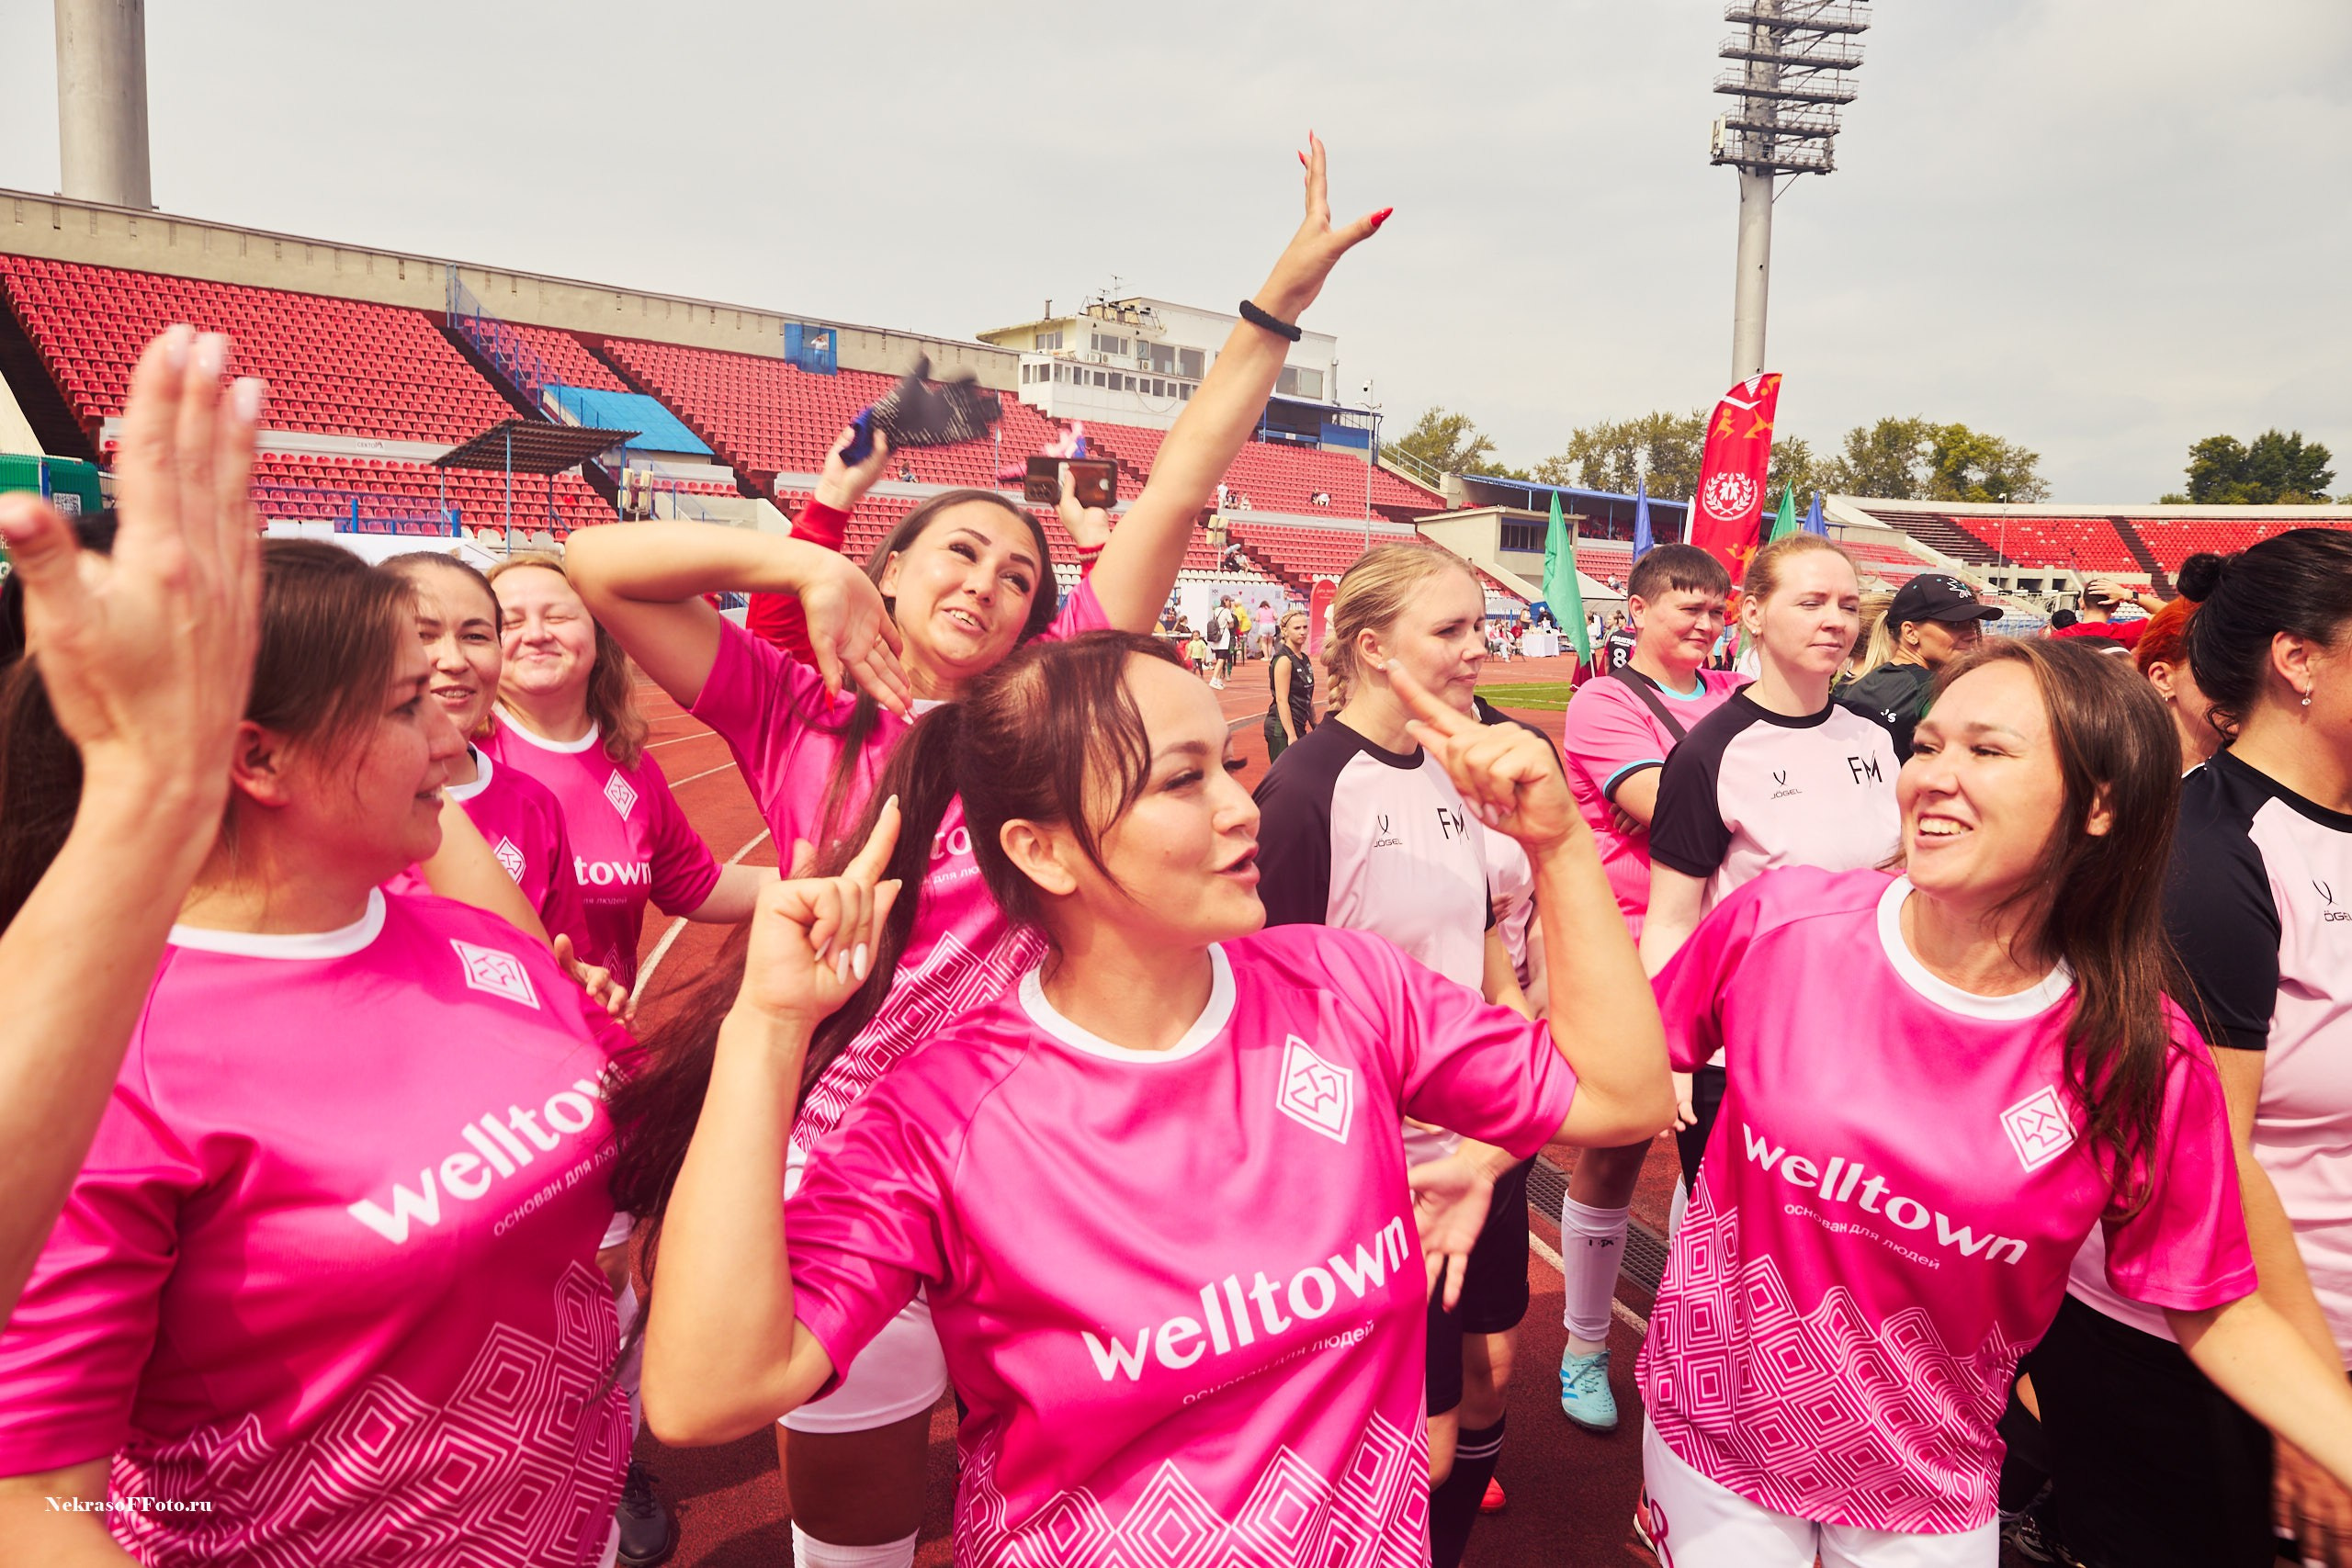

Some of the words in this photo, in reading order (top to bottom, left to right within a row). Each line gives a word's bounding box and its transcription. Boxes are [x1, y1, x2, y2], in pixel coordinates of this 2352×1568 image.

[1612, 648, 1627, 669] 8
[1770, 788, 1803, 800] JÖGEL
[1374, 838, 1403, 848] JÖGEL
[573, 855, 652, 886] town
[493, 1179, 563, 1236] основан
[564, 1158, 593, 1189] для
[1742, 1122, 2029, 1266] welltown
[1783, 1203, 1849, 1234] основан
[1849, 1223, 1880, 1241] для
[1882, 1238, 1940, 1270] людей
[1080, 1215, 1410, 1382] welltown
[1312, 1318, 1375, 1353] людей
